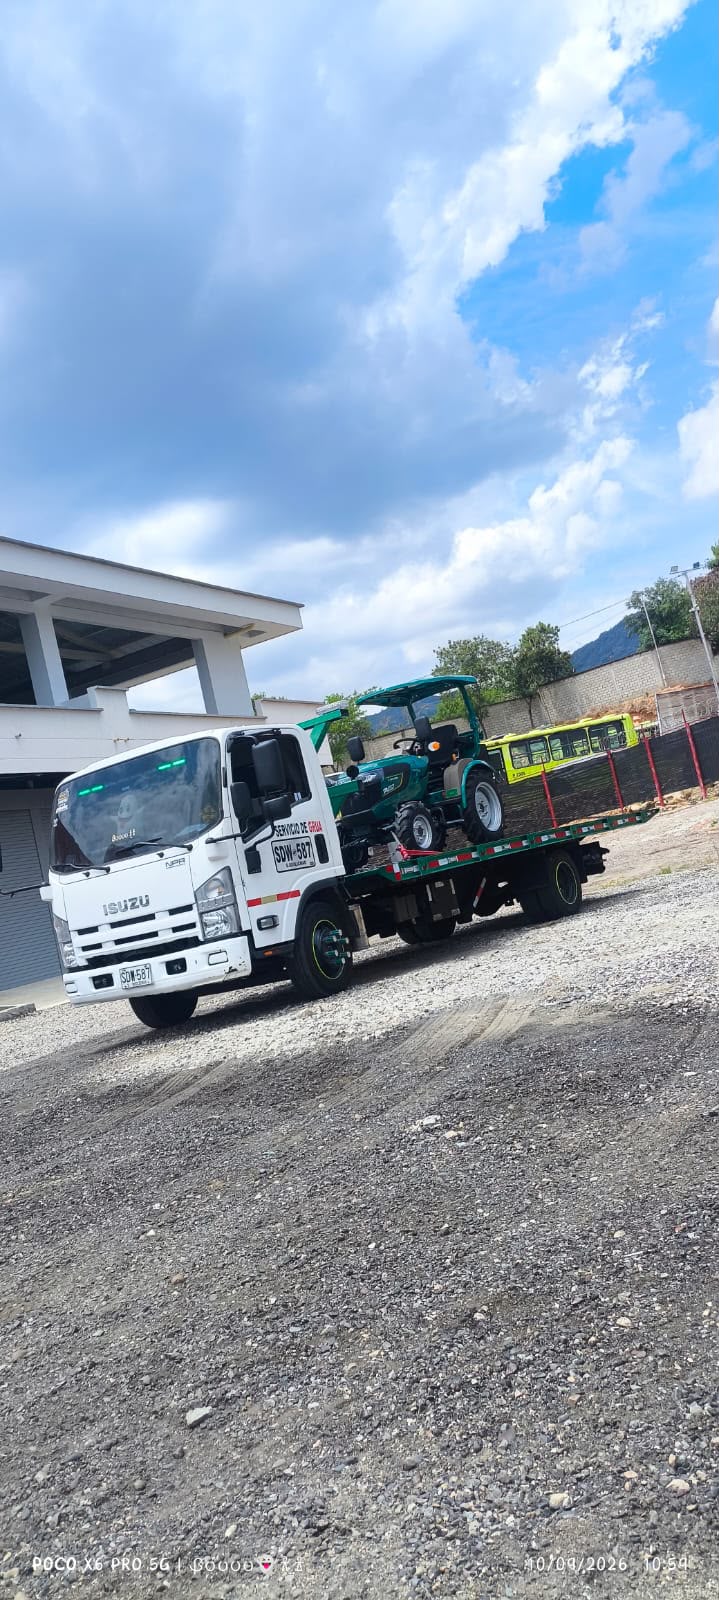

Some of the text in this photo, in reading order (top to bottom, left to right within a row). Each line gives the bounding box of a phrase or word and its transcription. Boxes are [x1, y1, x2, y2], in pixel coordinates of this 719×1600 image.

[274, 820, 322, 837] SERVICIO DE GRUA
[166, 857, 185, 869] NPR
[103, 894, 150, 916] ISUZU
